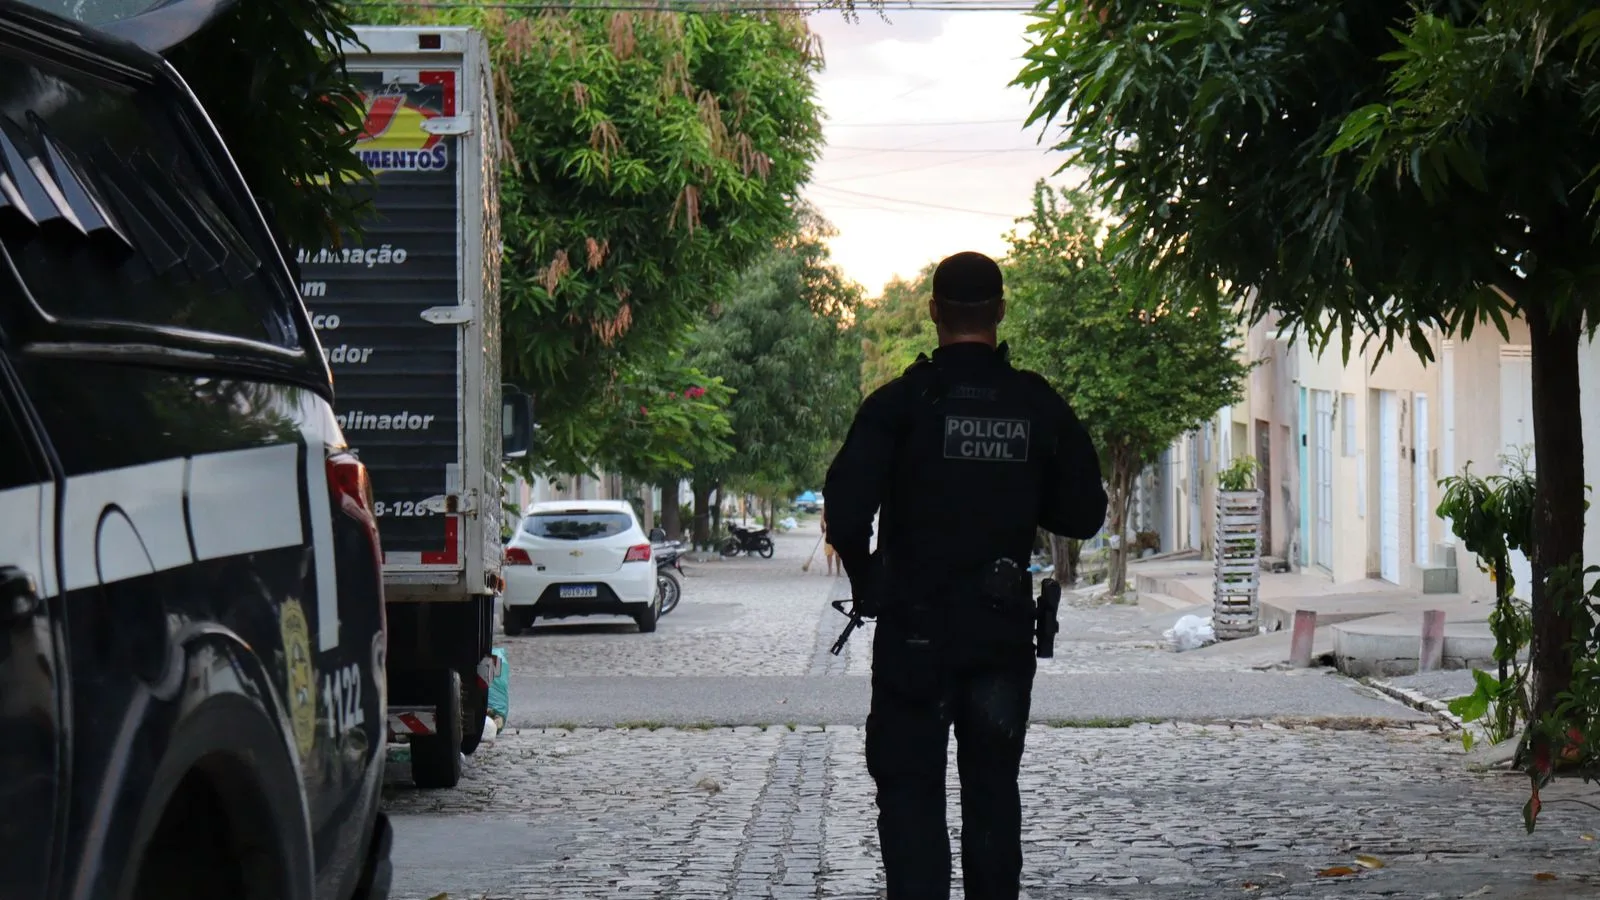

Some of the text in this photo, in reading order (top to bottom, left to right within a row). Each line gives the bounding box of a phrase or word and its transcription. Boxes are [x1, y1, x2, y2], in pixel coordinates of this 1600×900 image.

[301, 282, 326, 296] m
[947, 419, 1026, 439] POLICIA
[960, 440, 1014, 458] CIVIL
[374, 501, 434, 517] 8-126
[323, 663, 364, 738] 1122
